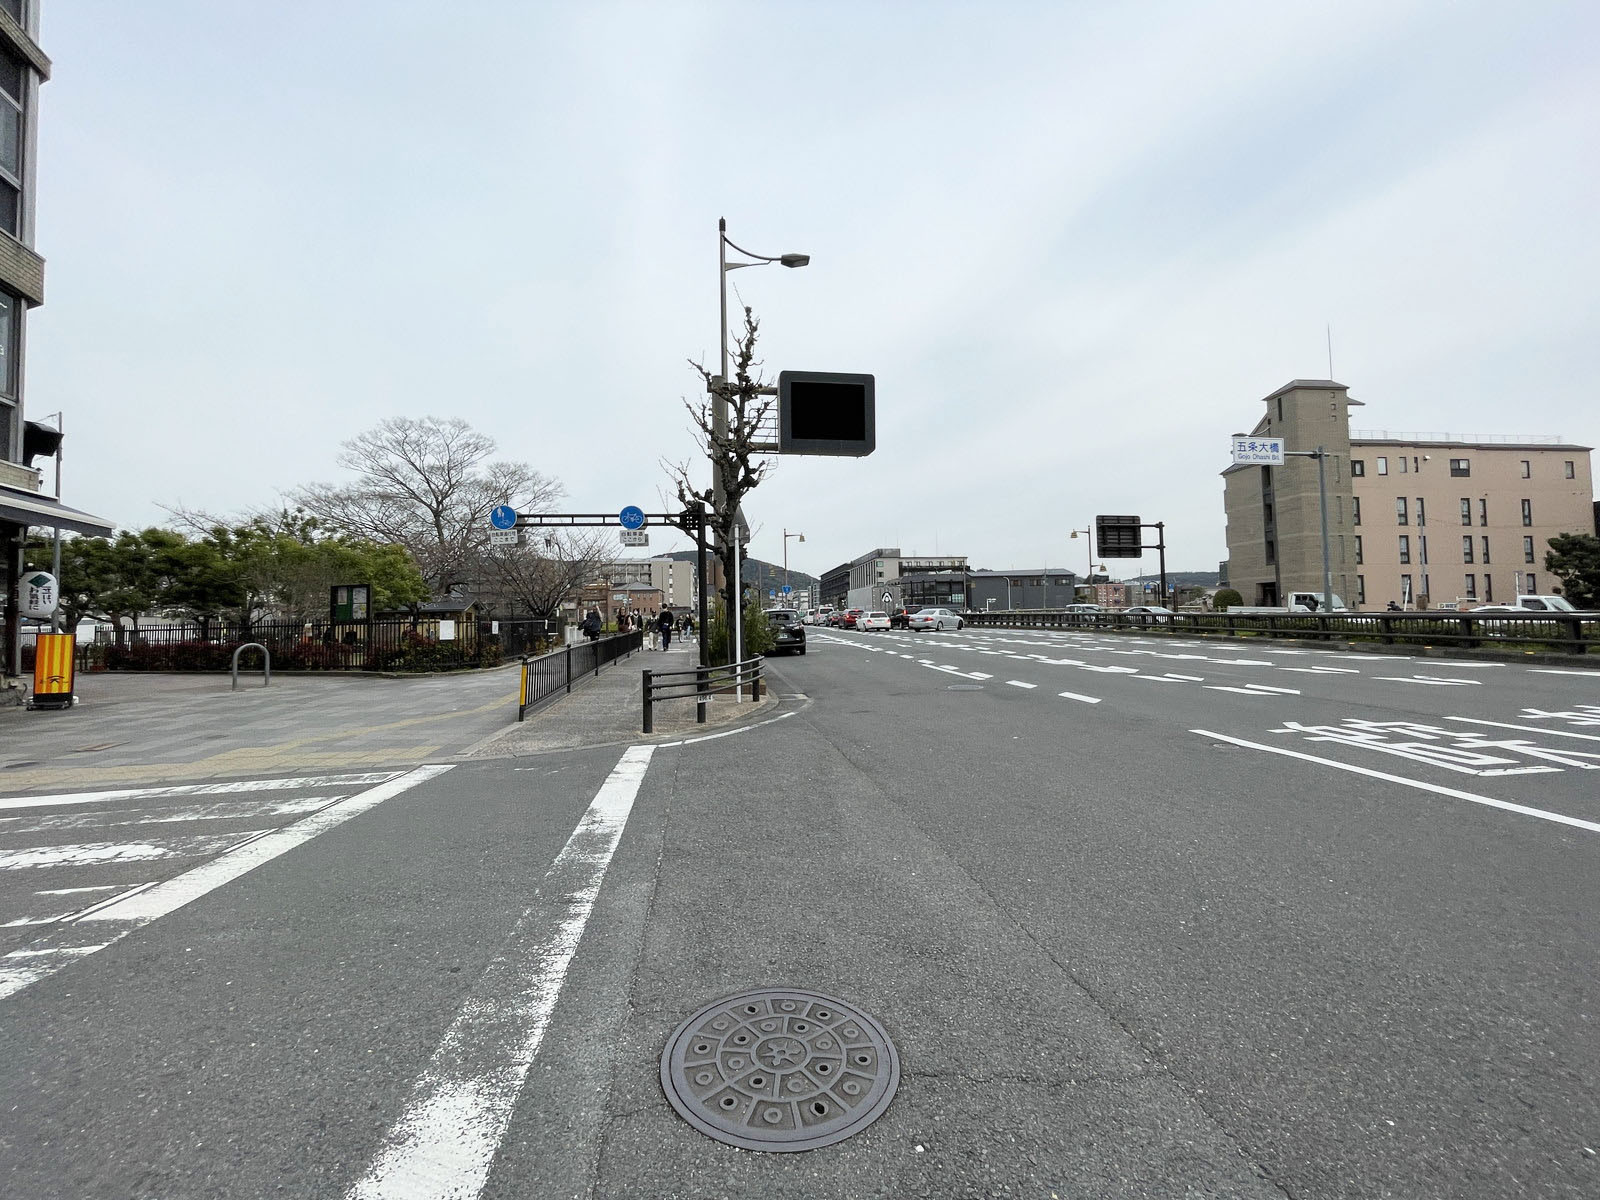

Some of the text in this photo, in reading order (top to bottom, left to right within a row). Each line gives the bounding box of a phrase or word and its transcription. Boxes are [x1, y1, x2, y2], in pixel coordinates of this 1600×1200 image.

[1237, 441, 1279, 453] 五条大橋
[1238, 453, 1251, 461] Gojo
